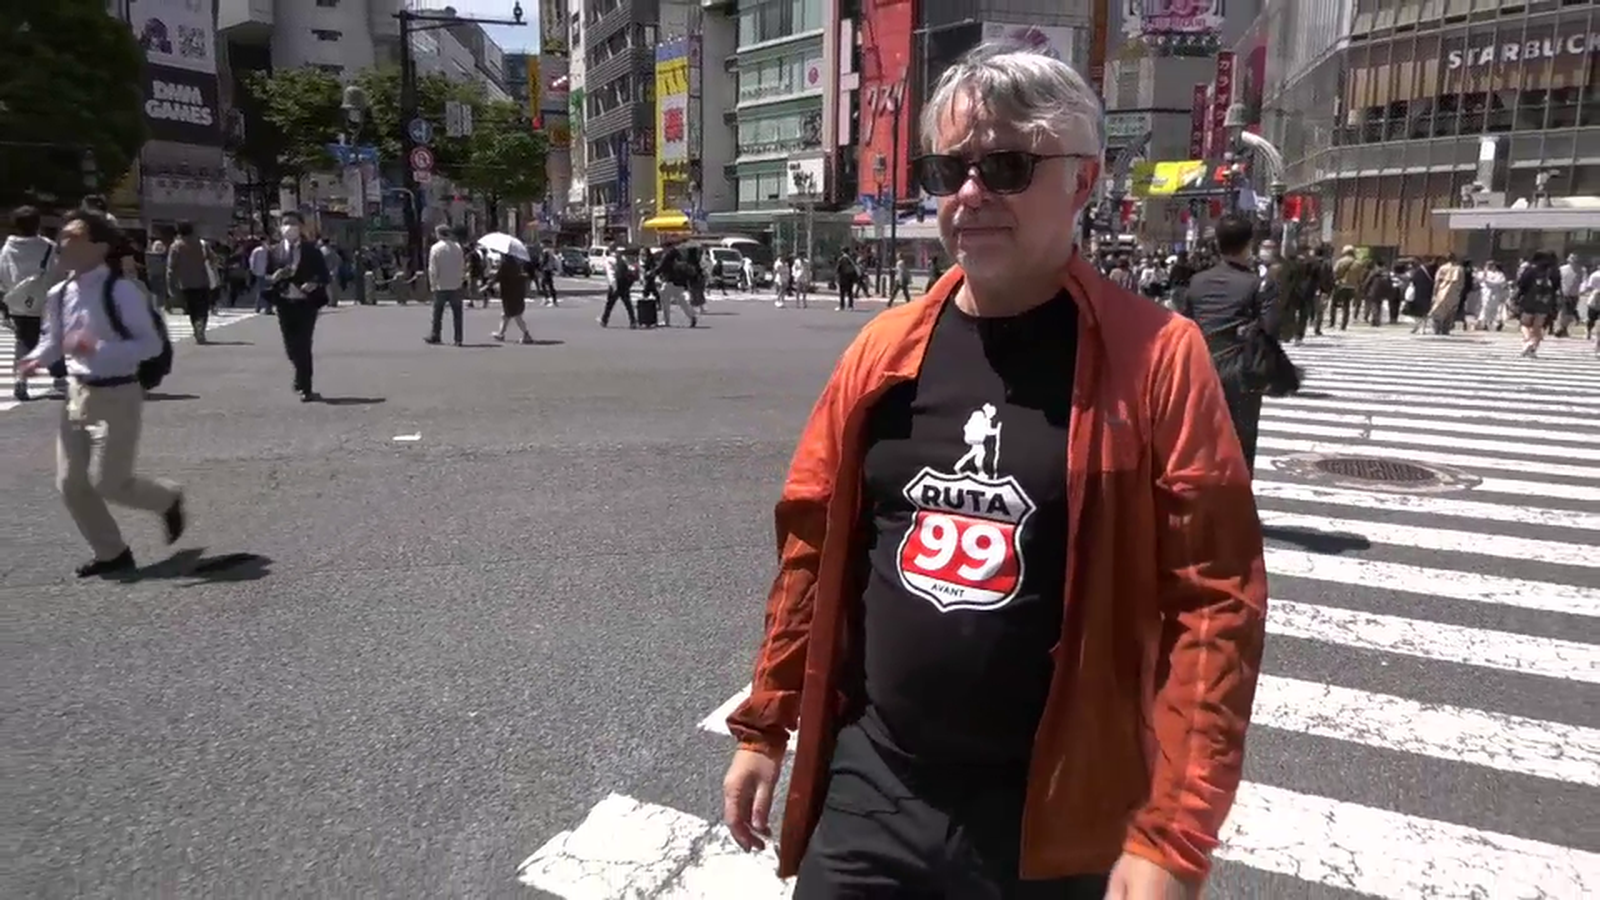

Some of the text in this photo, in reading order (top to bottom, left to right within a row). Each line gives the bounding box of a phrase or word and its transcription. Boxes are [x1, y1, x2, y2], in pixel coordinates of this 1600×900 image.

[152, 80, 203, 106] DMM
[145, 100, 213, 126] GAMES
[921, 485, 1011, 516] RUTA
[913, 515, 1007, 581] 99
[930, 583, 965, 598] AVANT
